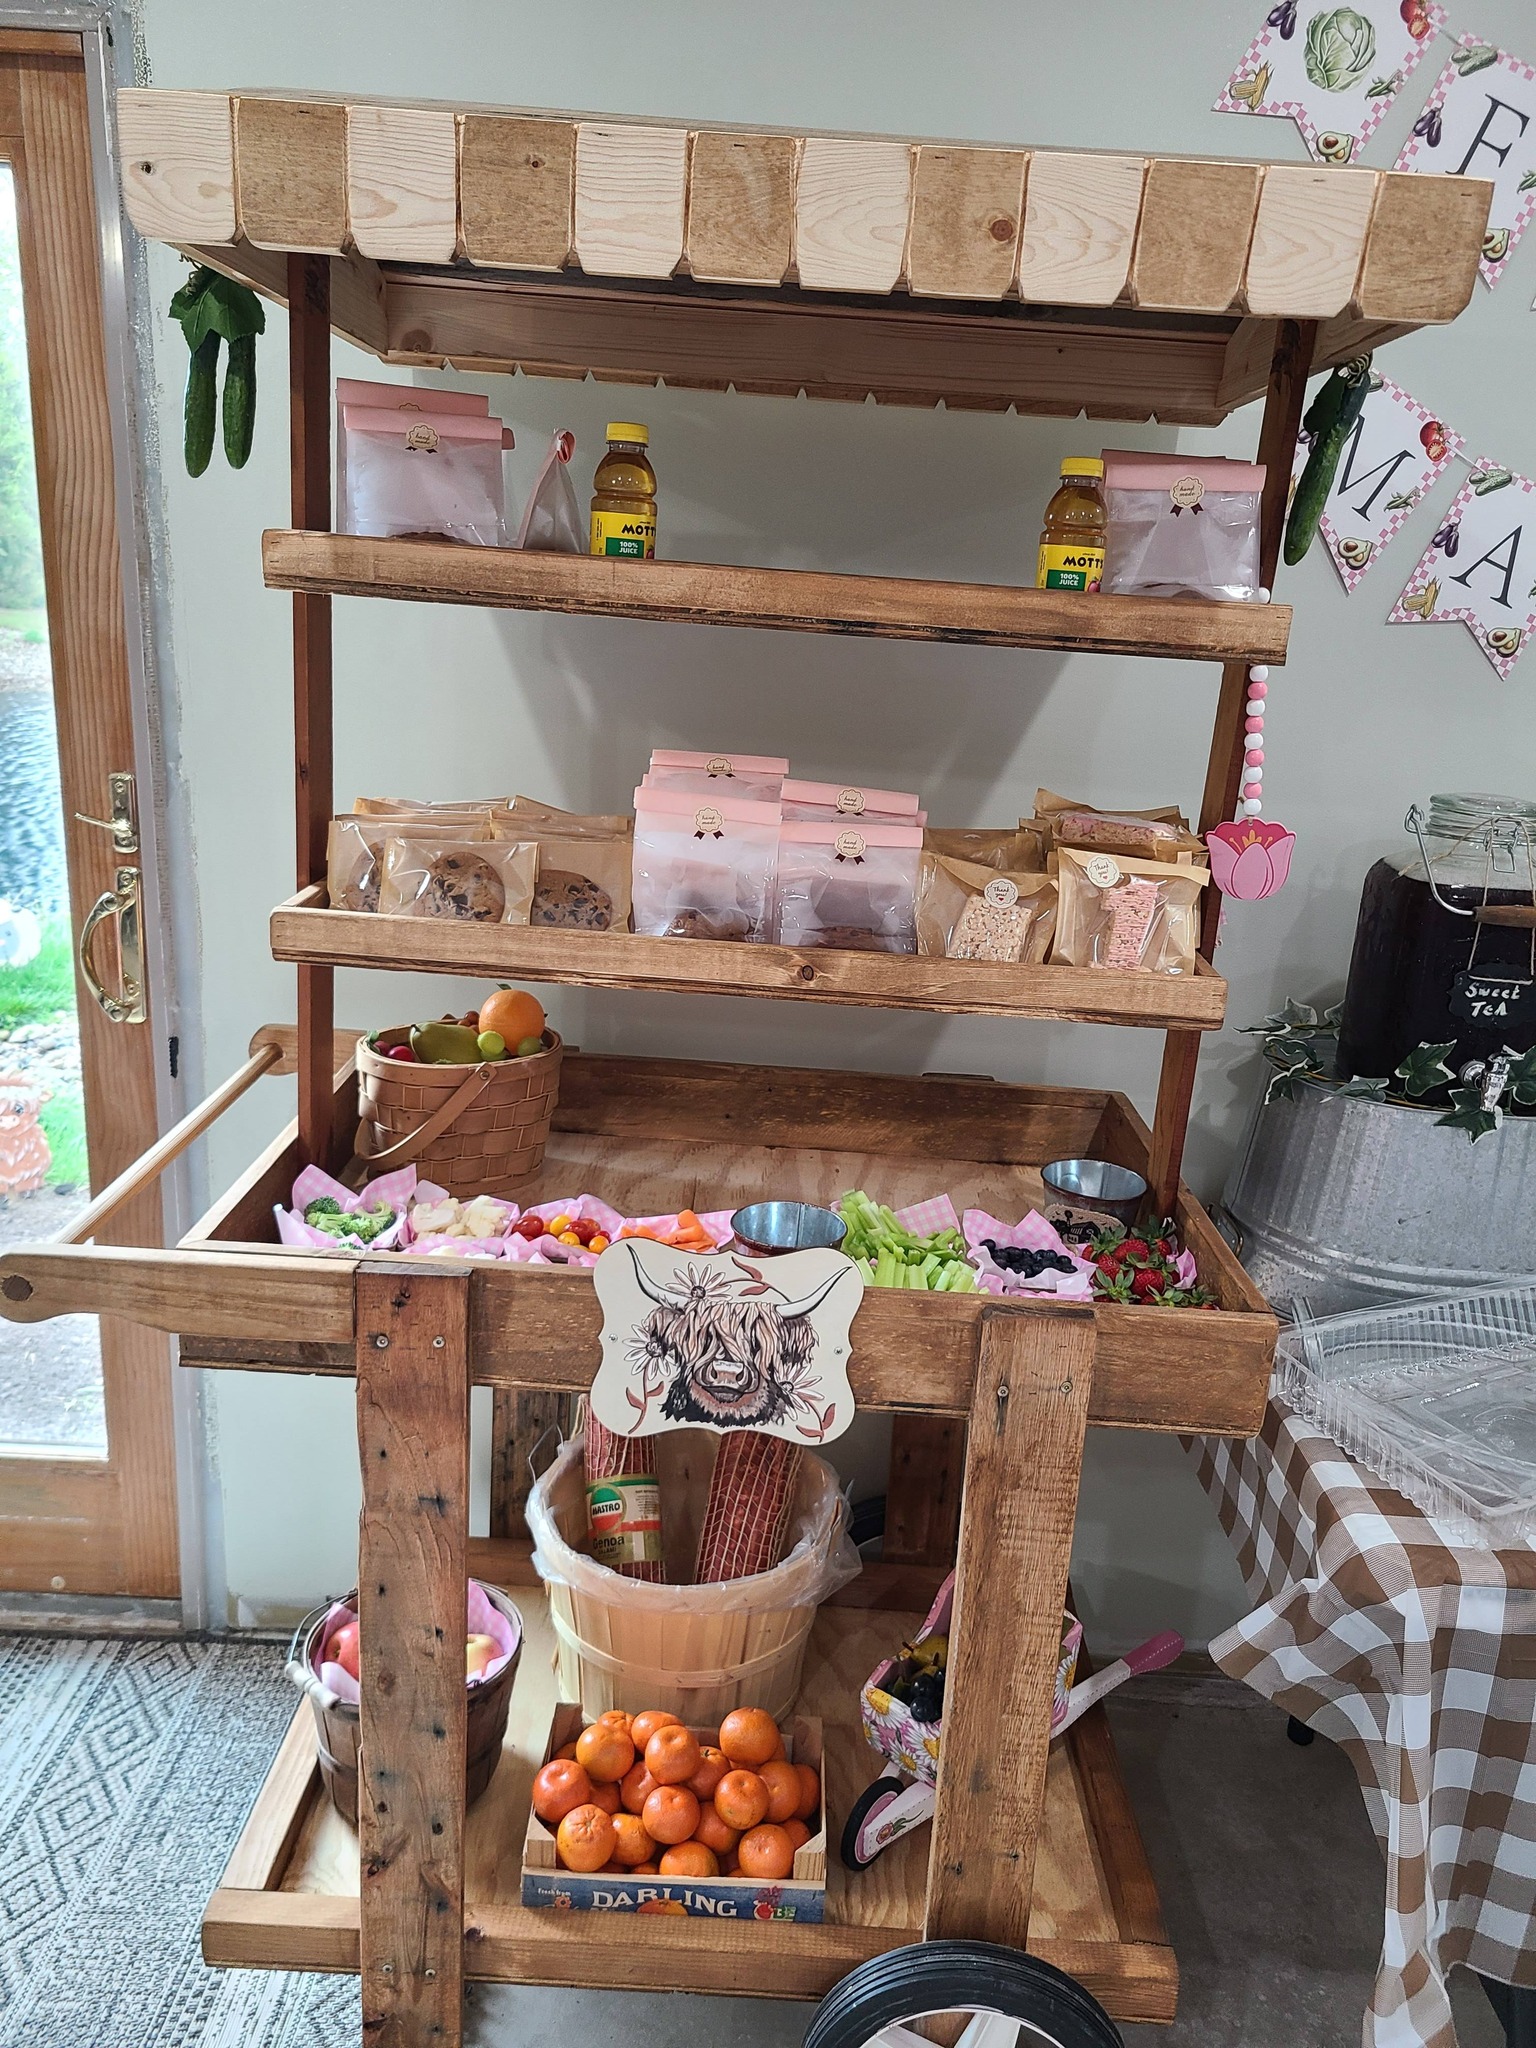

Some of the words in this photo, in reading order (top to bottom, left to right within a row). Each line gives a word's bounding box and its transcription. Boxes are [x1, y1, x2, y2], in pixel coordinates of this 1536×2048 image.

[1445, 93, 1531, 175] F
[621, 524, 656, 537] MOTT
[619, 547, 638, 555] JUICE
[1449, 525, 1523, 609] A
[1093, 863, 1109, 871] Thank
[1464, 981, 1521, 1000] Sweet
[592, 1502, 621, 1516] MASTRO
[593, 1535, 625, 1550] Genoa
[592, 1888, 738, 1917] DARLING
